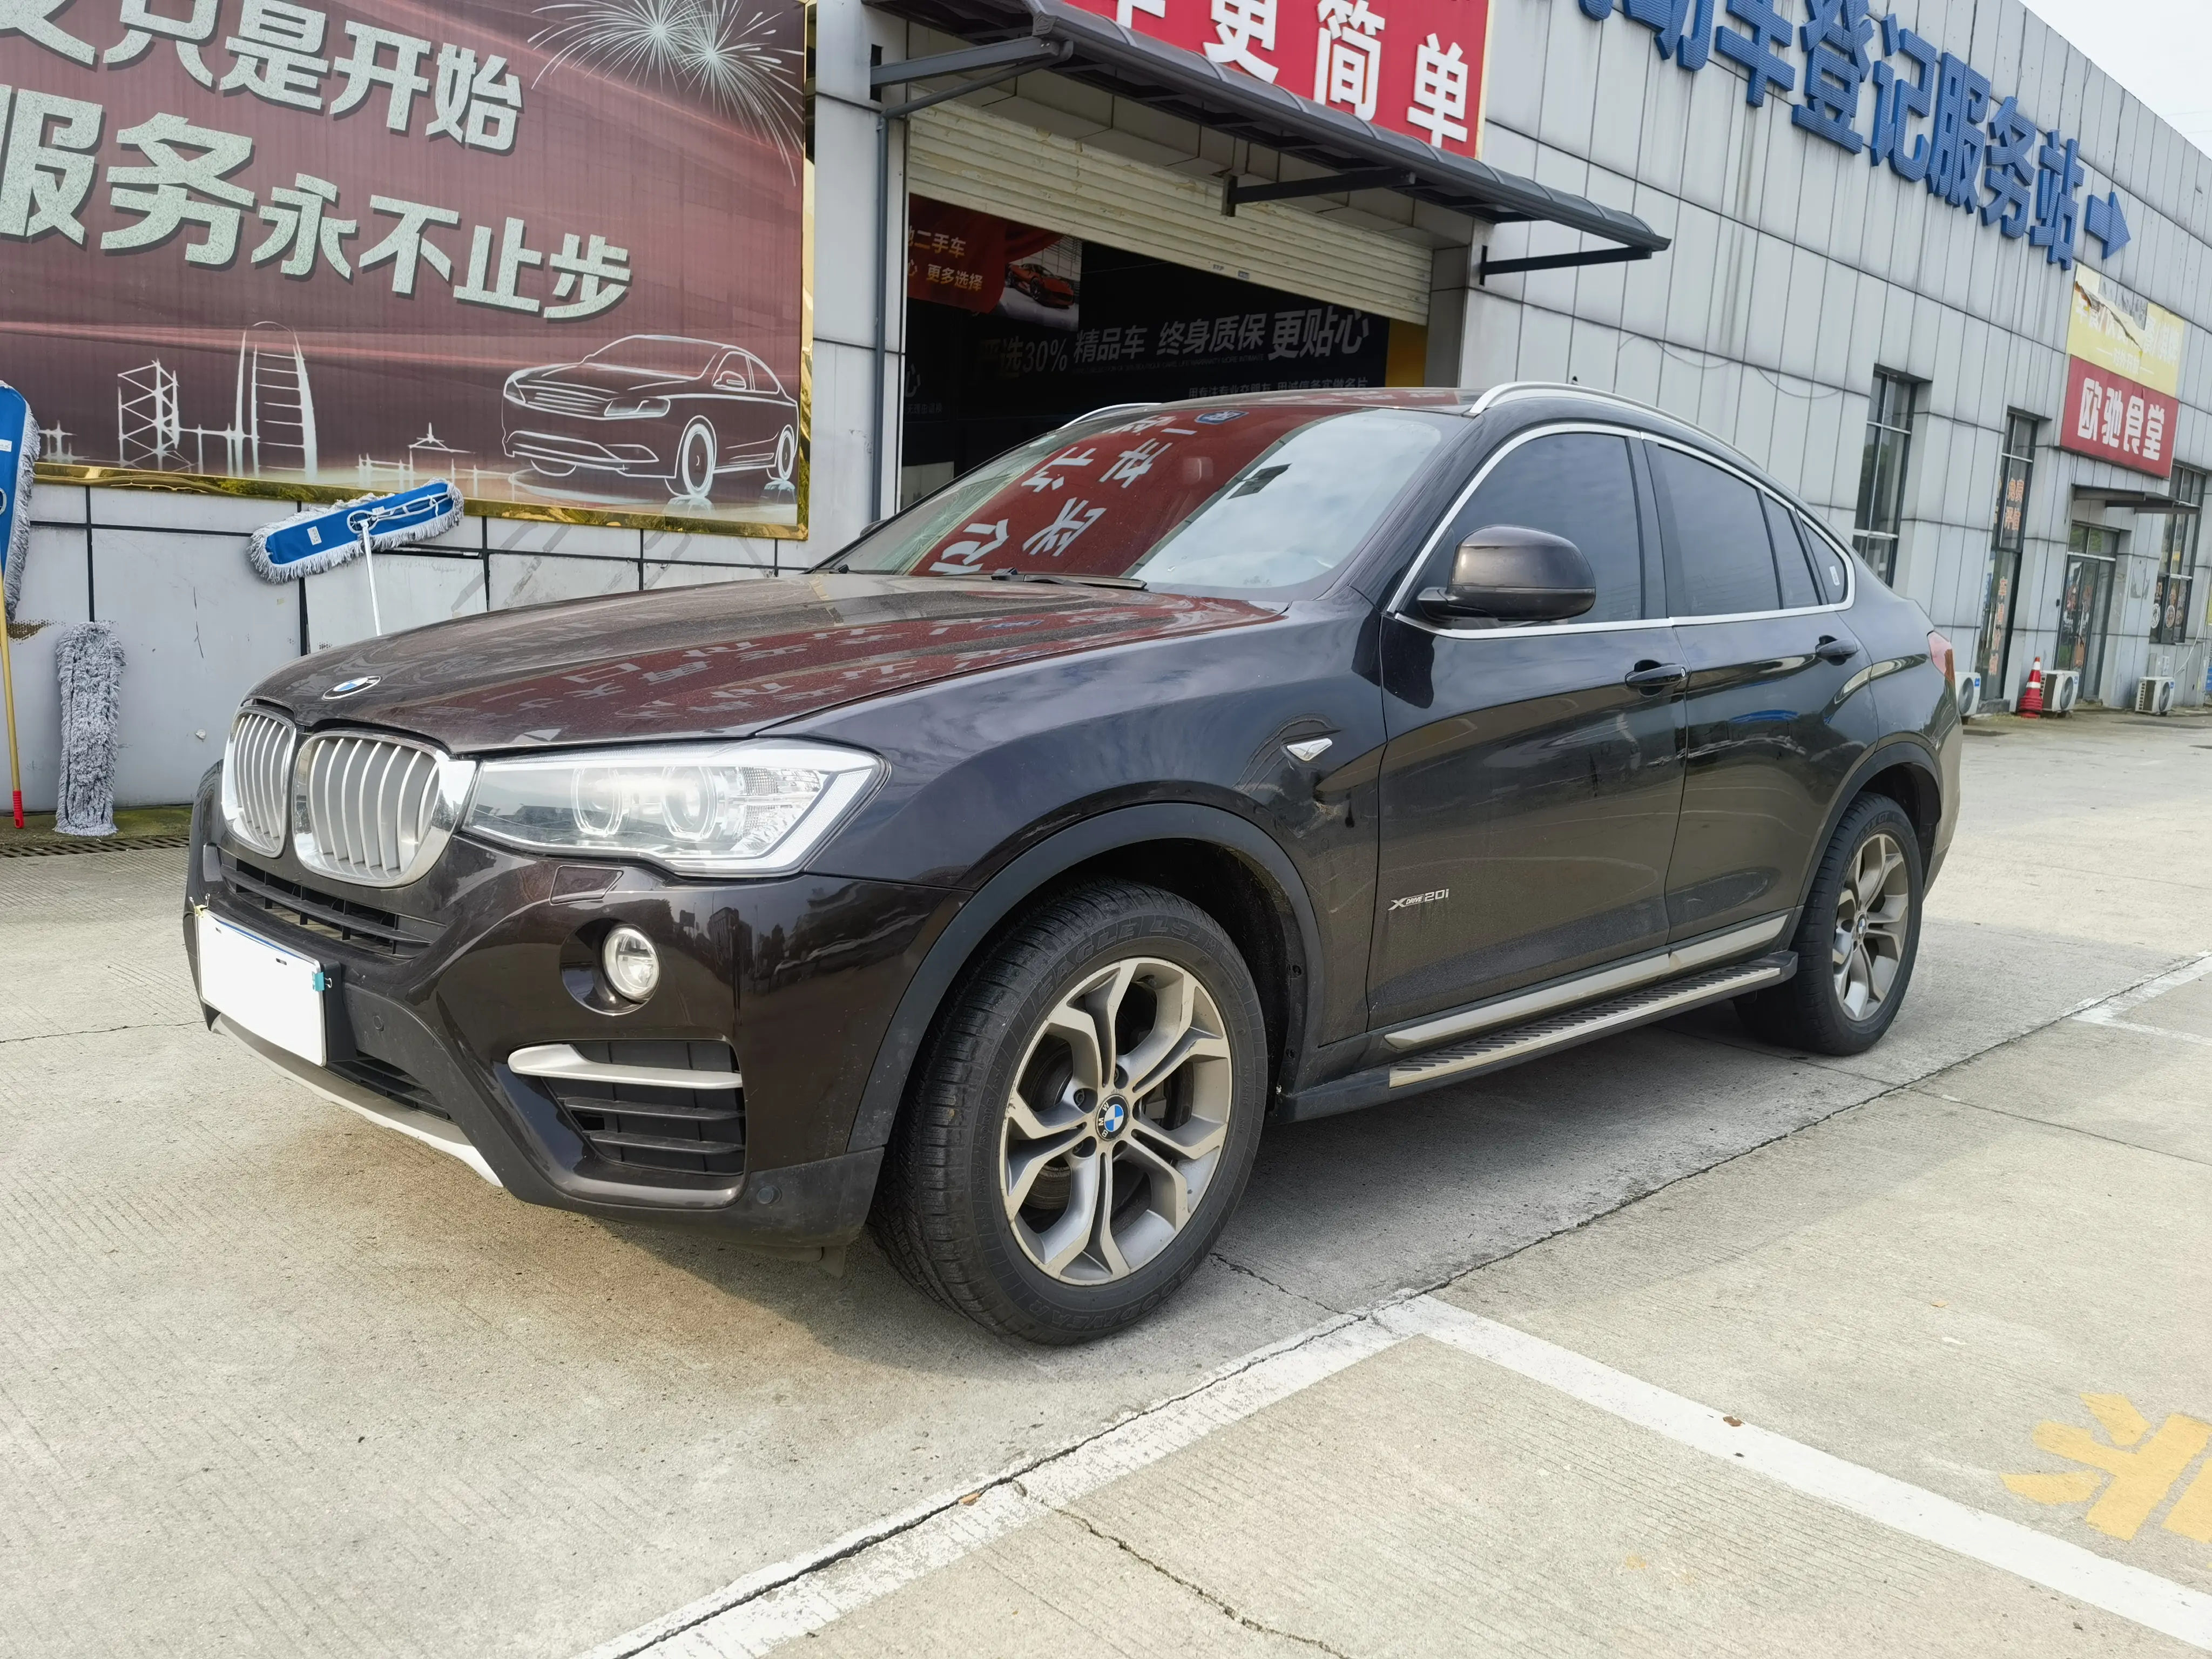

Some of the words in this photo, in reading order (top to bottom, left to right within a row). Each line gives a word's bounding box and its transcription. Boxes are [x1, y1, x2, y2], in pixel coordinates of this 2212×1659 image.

[1117, 0, 1469, 147] 更简单
[1579, 0, 2085, 271] 车登记服务站
[0, 84, 631, 318] 服务永不止步
[926, 264, 983, 292] 更多选择
[1073, 325, 1148, 363] 精品车
[1156, 313, 1267, 356] 终身质保
[1267, 305, 1370, 361] 更贴心
[2077, 377, 2164, 461] 欧驰食堂
